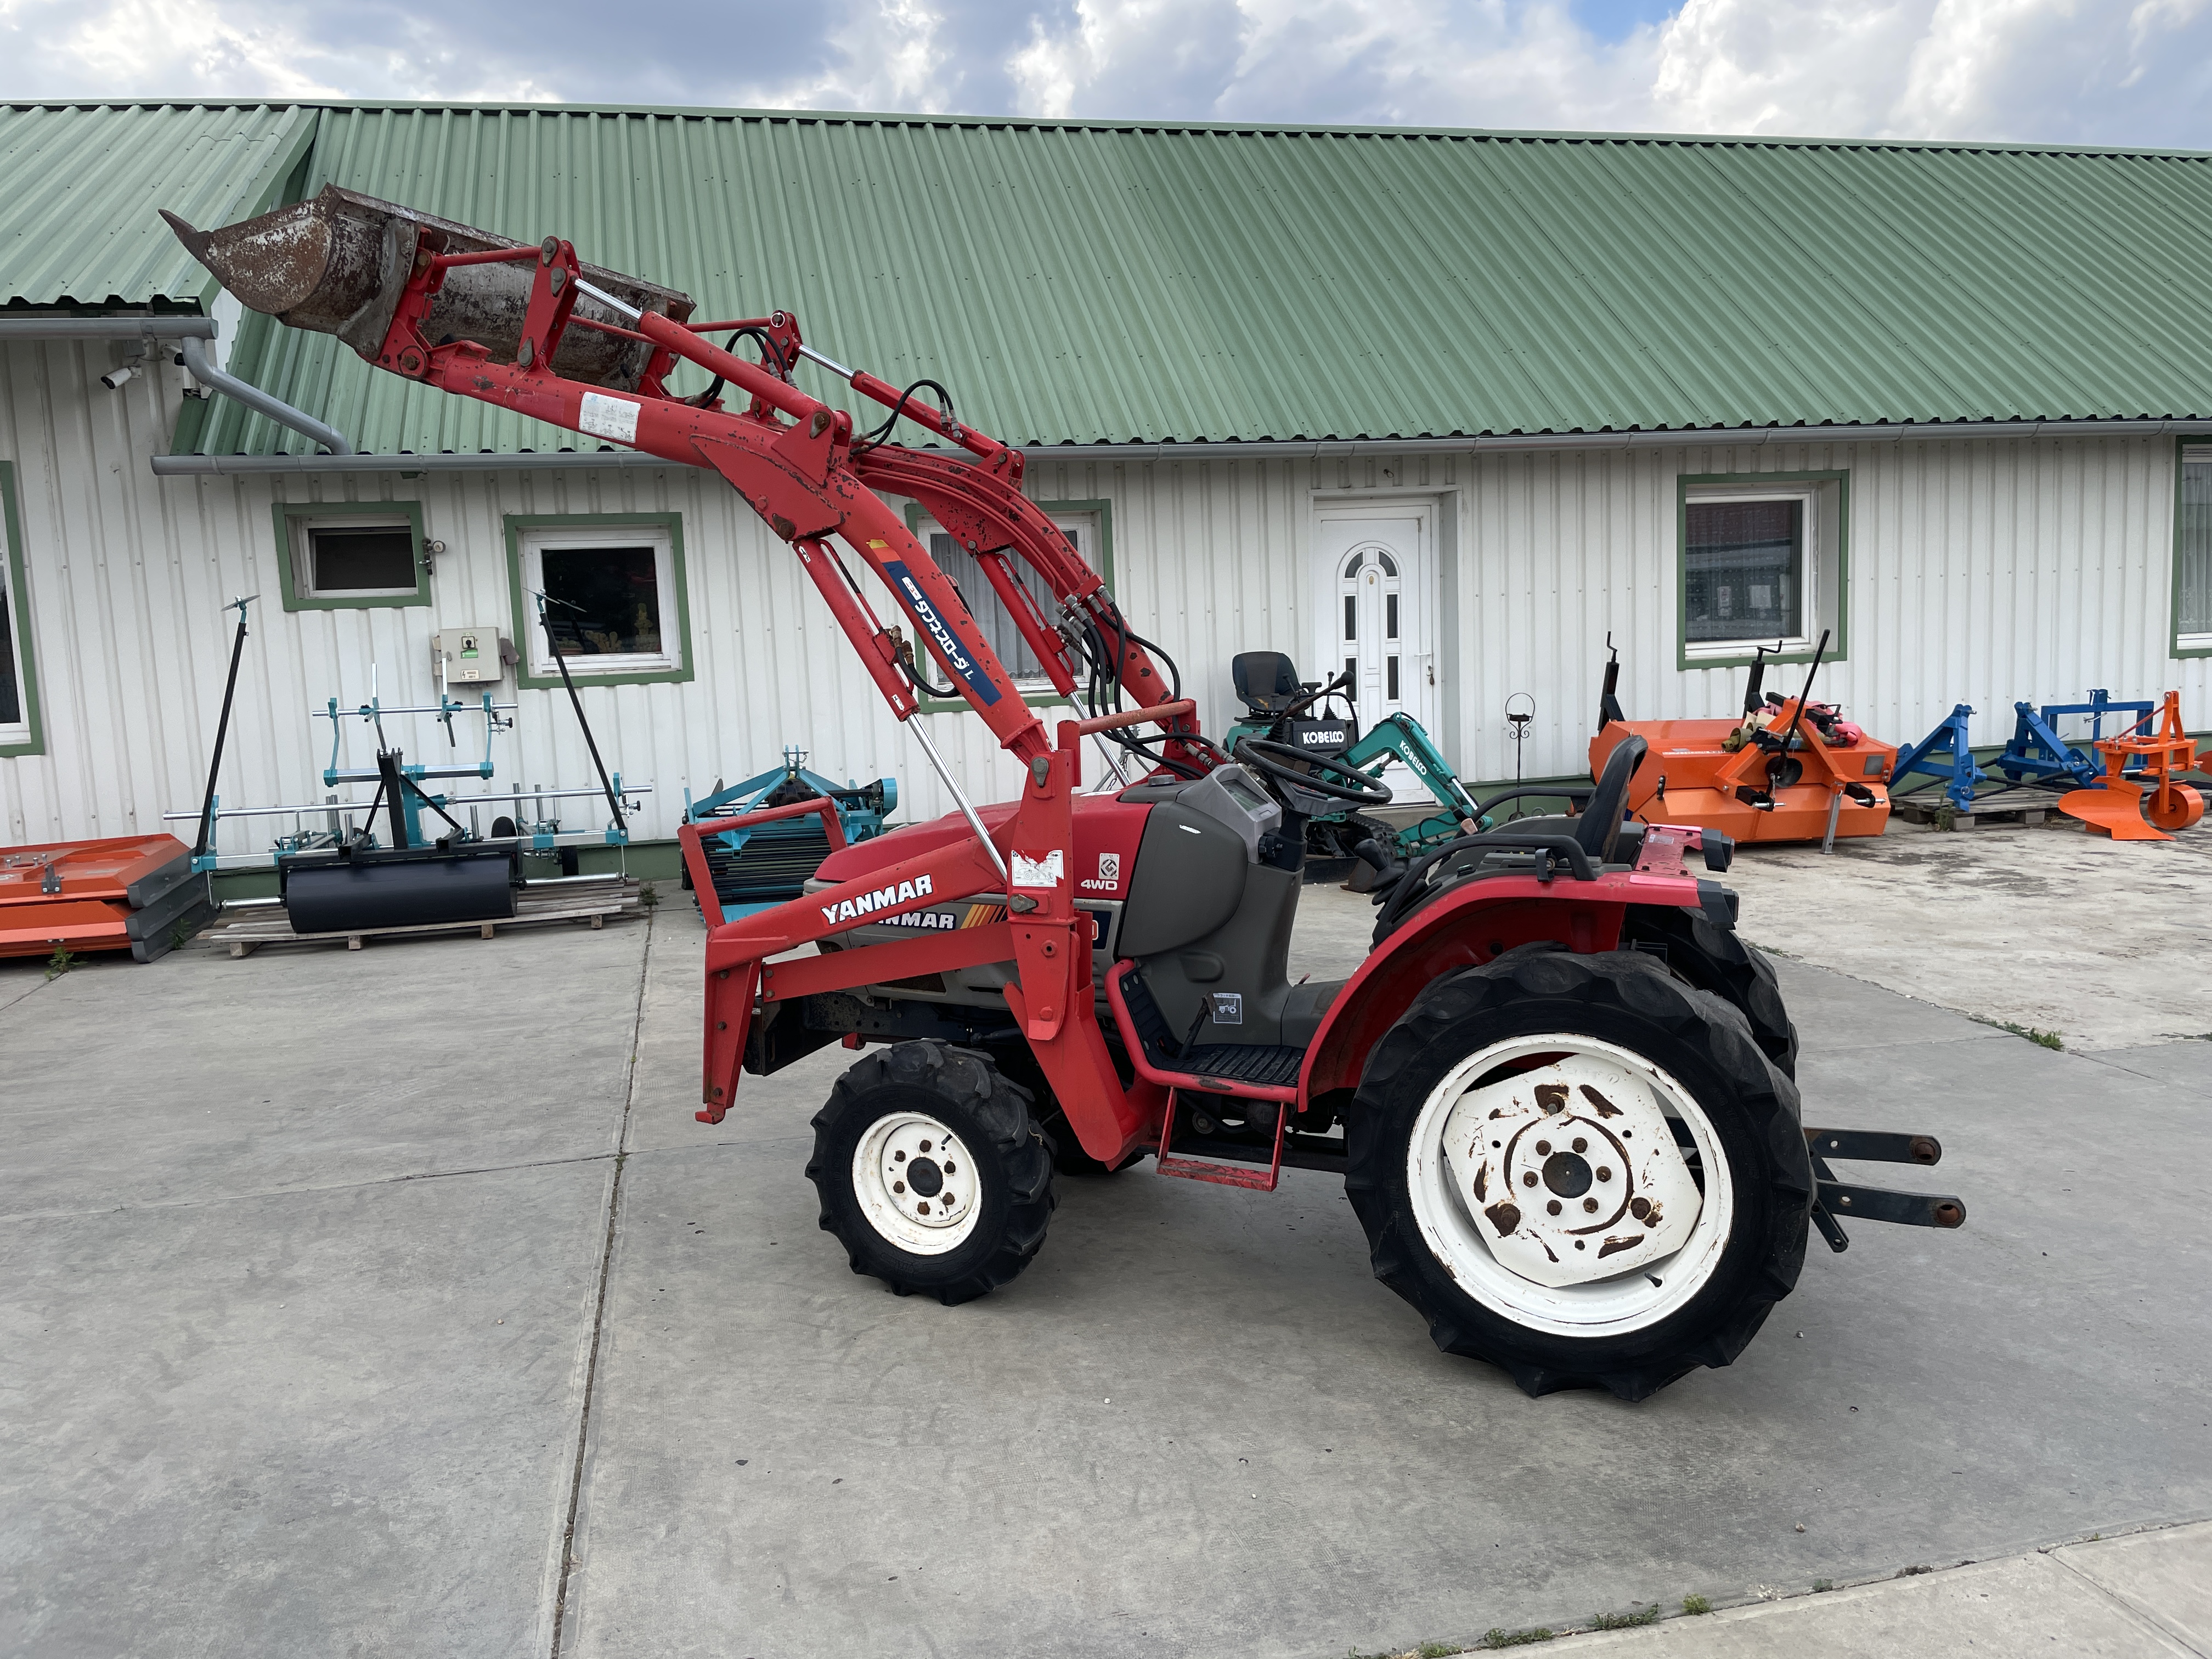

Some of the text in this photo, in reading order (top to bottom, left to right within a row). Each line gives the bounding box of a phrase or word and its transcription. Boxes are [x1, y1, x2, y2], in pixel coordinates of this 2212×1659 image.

[1302, 731, 1344, 744] KOBELCO
[1399, 740, 1426, 775] KOBELCO
[1080, 879, 1118, 890] 4WD
[821, 874, 933, 925] YANMAR
[878, 912, 954, 929] NMAR
